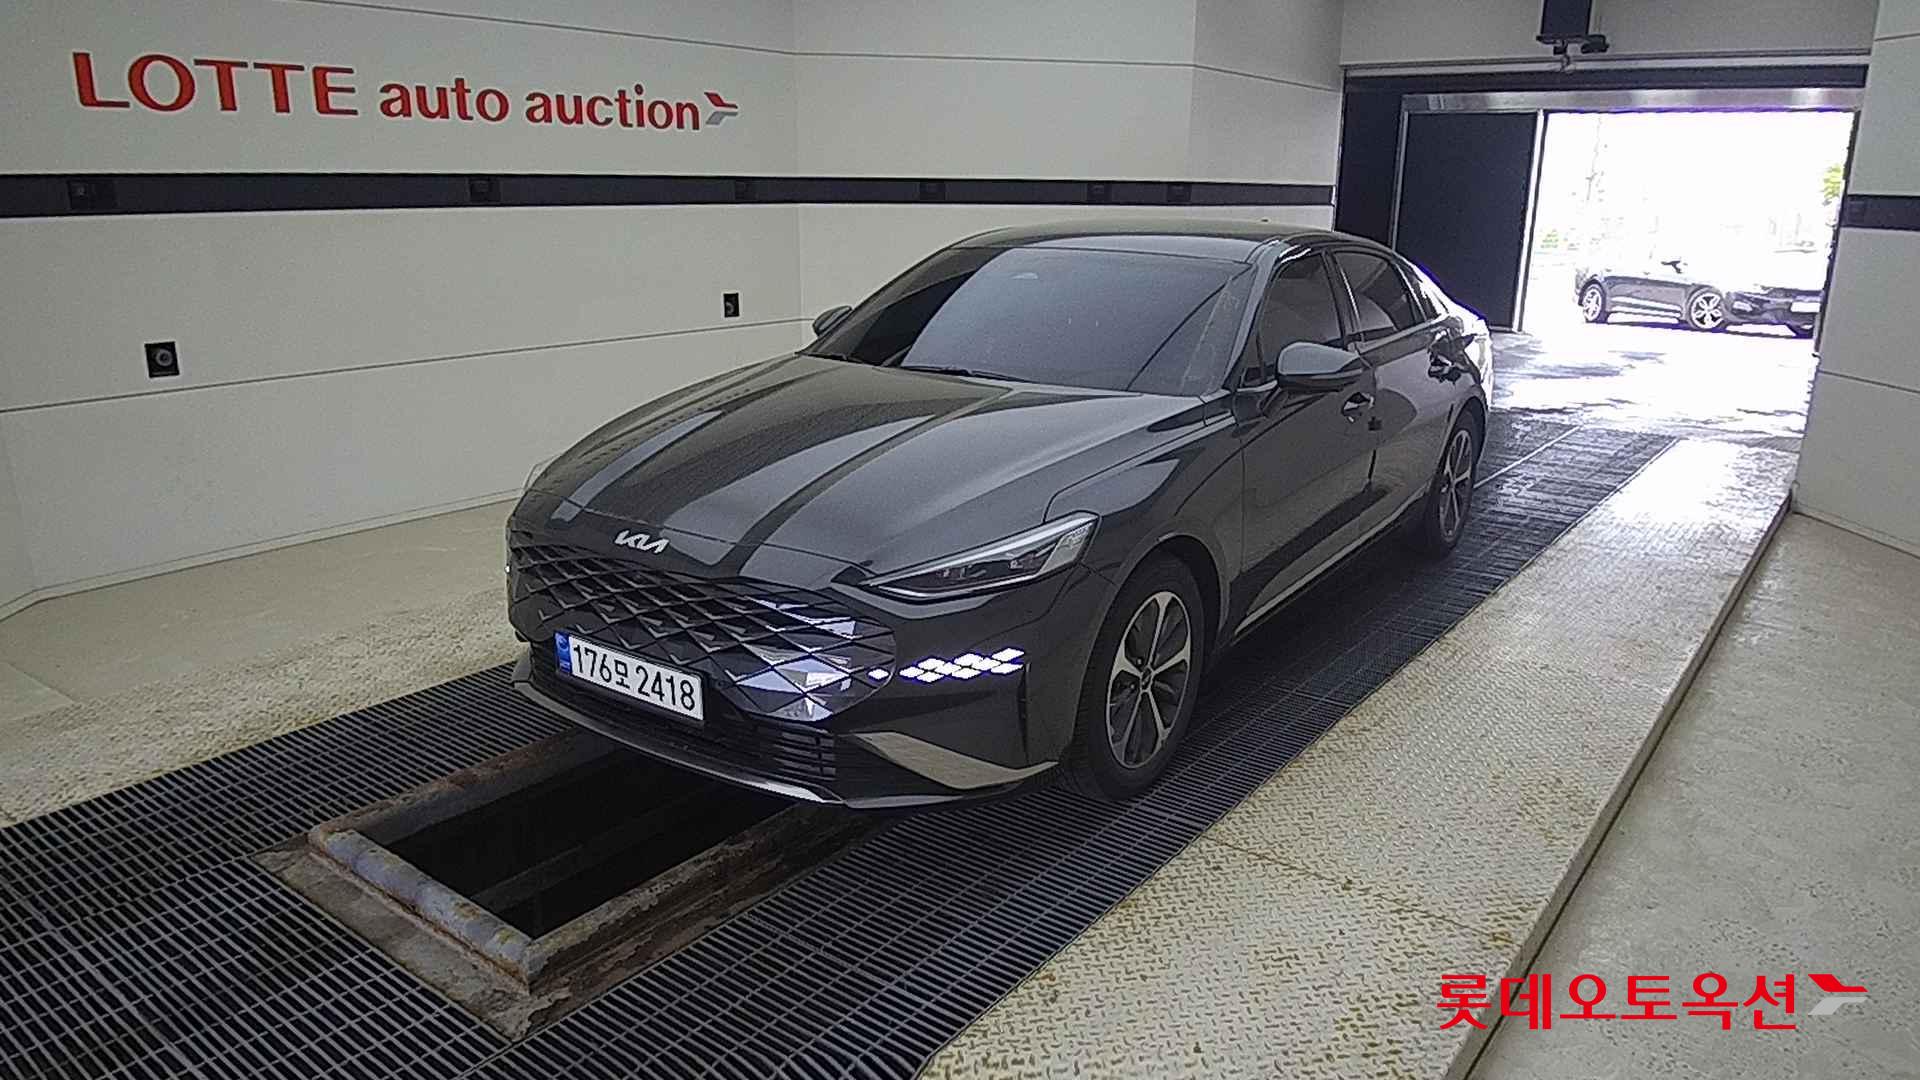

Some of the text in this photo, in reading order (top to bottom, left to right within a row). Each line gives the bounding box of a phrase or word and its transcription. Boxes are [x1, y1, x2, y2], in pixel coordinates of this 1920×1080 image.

[73, 52, 700, 131] LOTTE auto auction
